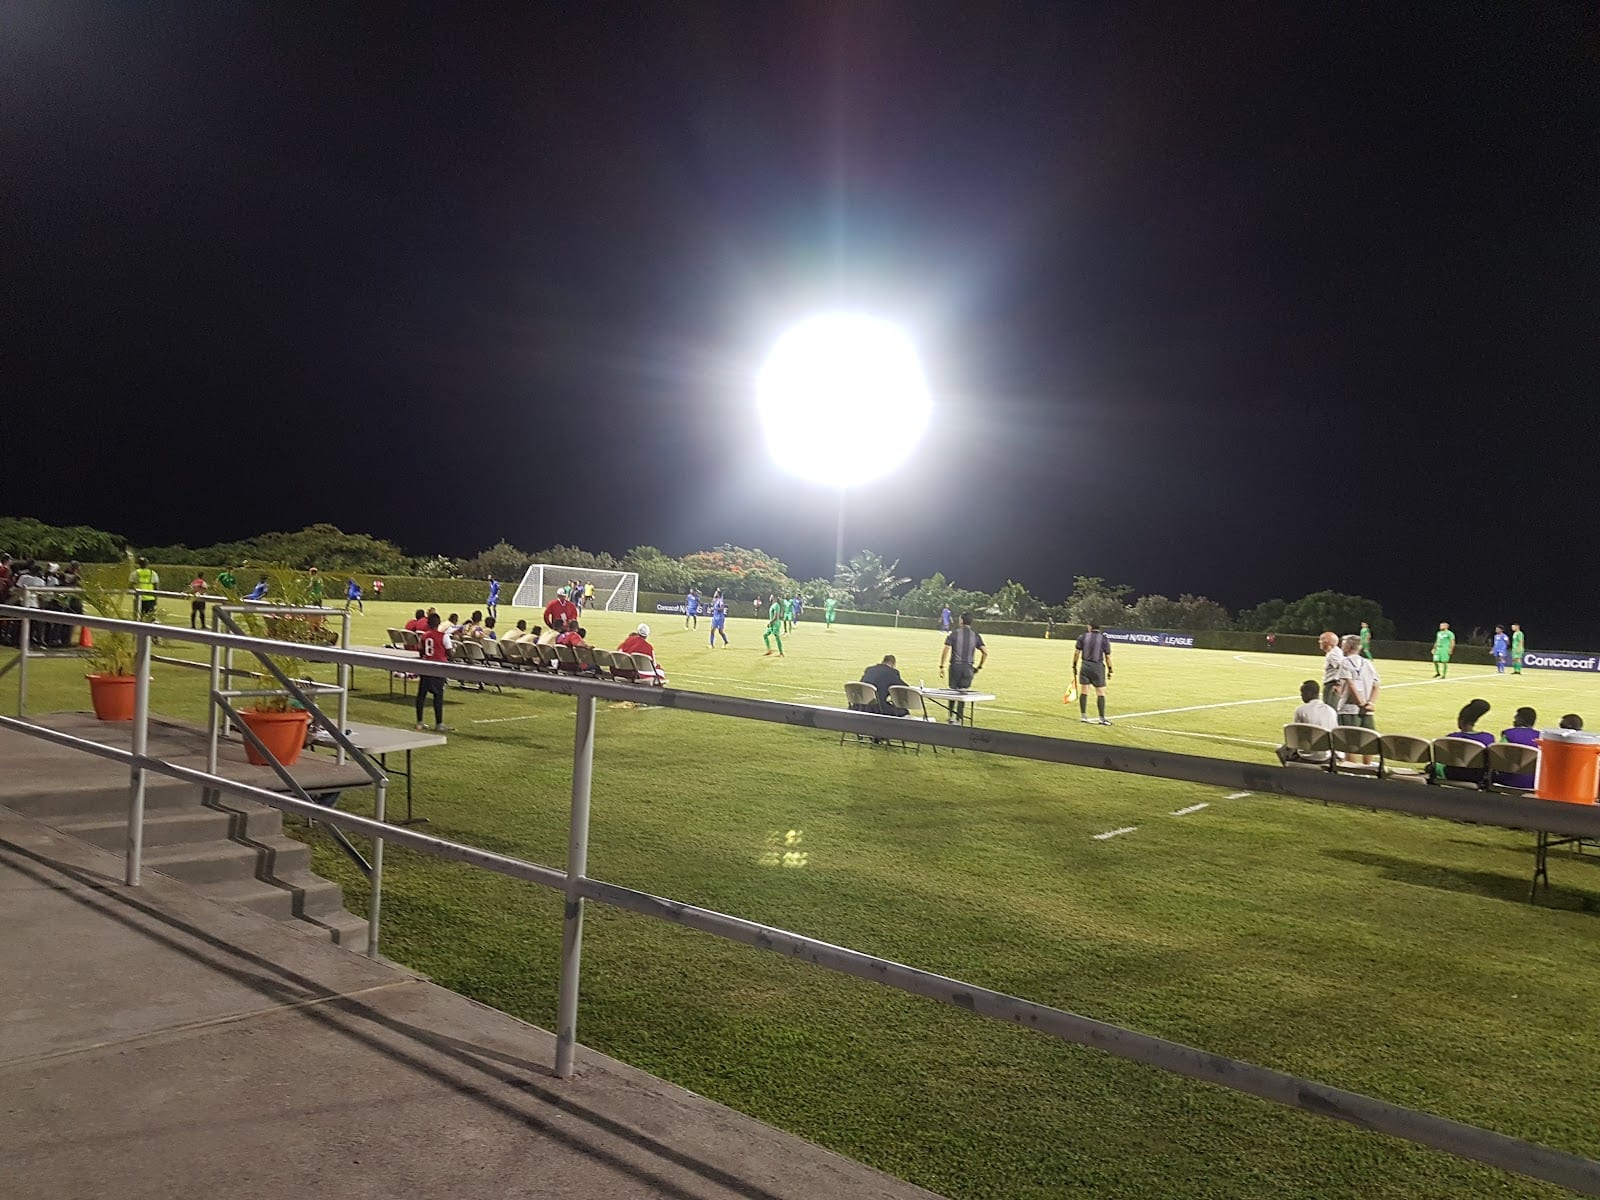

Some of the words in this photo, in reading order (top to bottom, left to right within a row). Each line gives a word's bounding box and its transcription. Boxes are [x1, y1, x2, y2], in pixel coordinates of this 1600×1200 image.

[1129, 634, 1159, 642] NATIONS
[1165, 636, 1194, 646] LEAGUE
[1524, 654, 1596, 669] Concacaf
